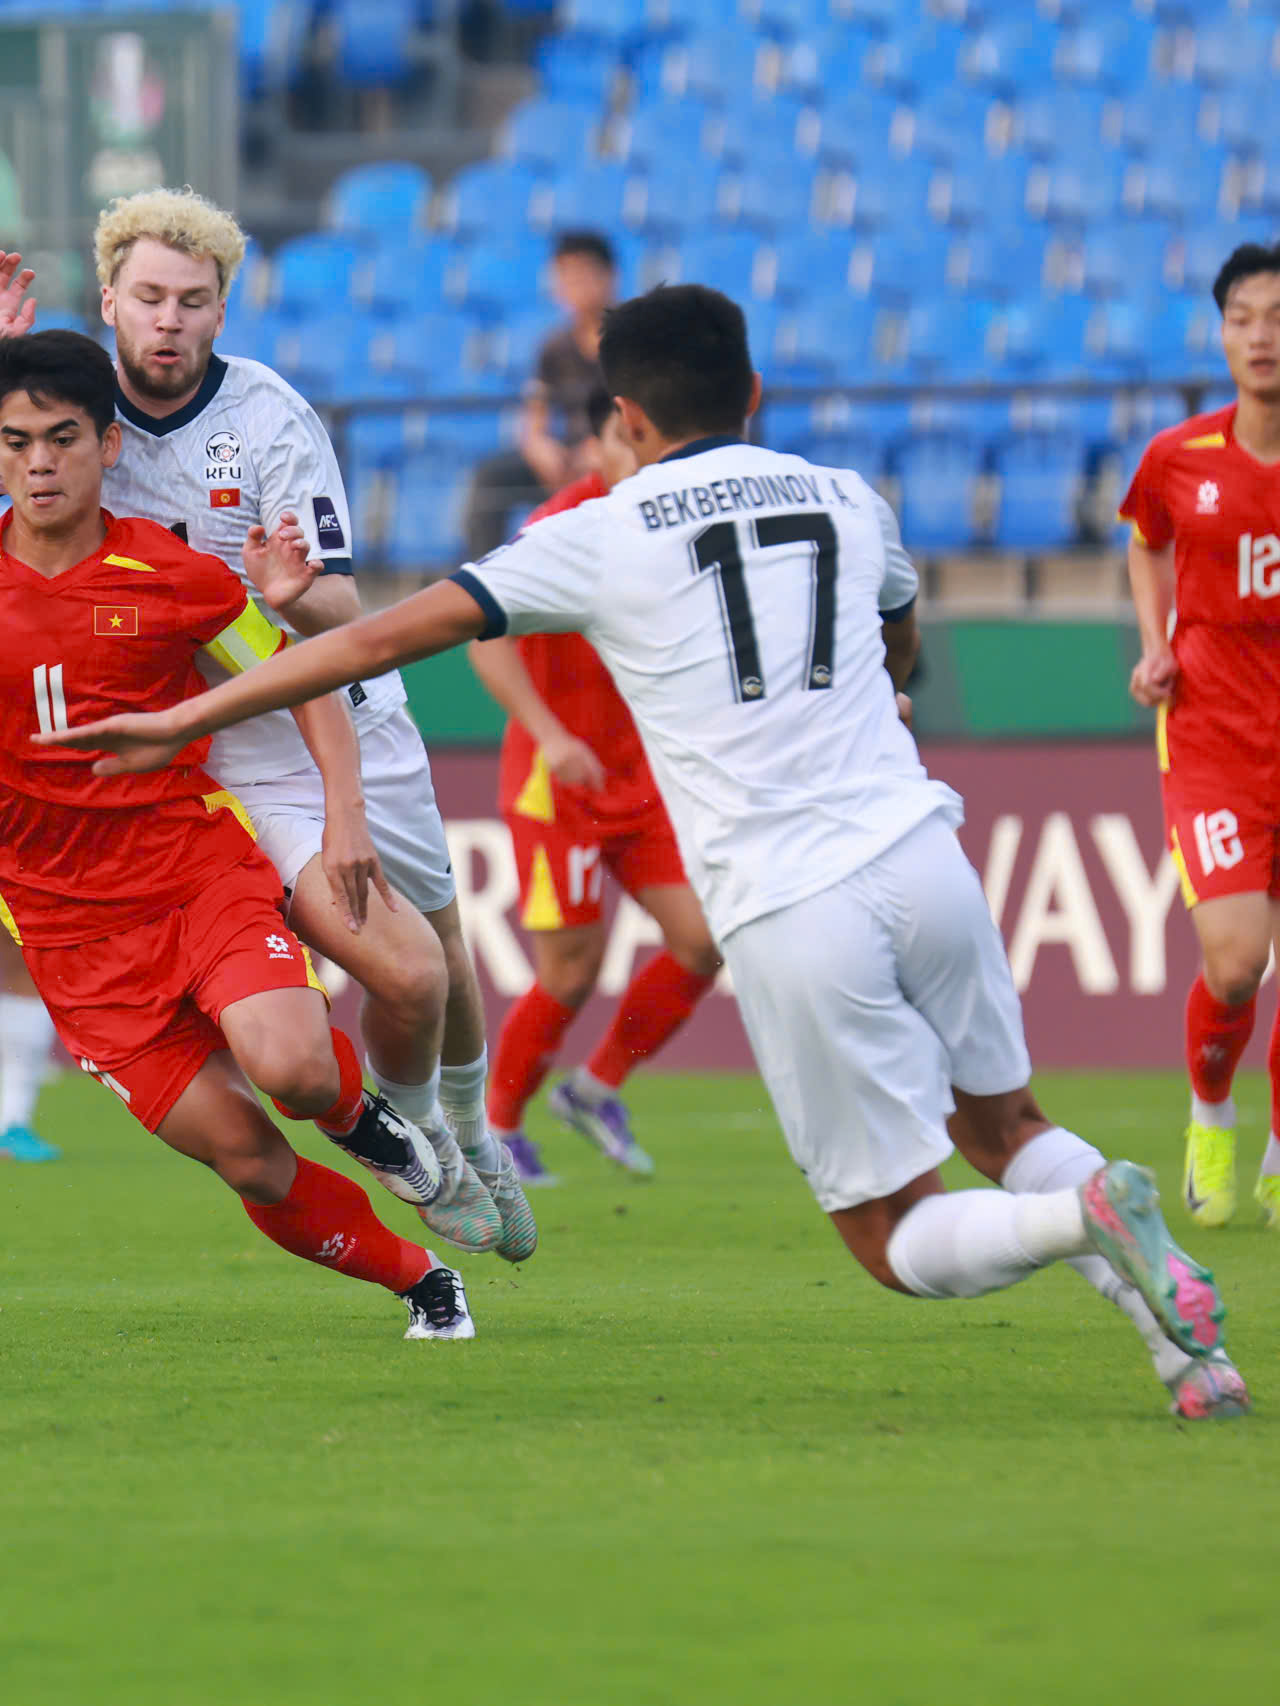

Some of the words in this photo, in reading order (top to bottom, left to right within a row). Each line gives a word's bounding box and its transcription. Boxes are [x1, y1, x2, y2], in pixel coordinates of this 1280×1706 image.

[206, 466, 242, 480] KFU
[638, 474, 824, 532] BEKBERDINOV
[319, 514, 339, 529] AFC
[1237, 532, 1280, 599] 12
[687, 511, 840, 704] 17
[33, 663, 68, 734] 11
[1193, 808, 1244, 876] 12
